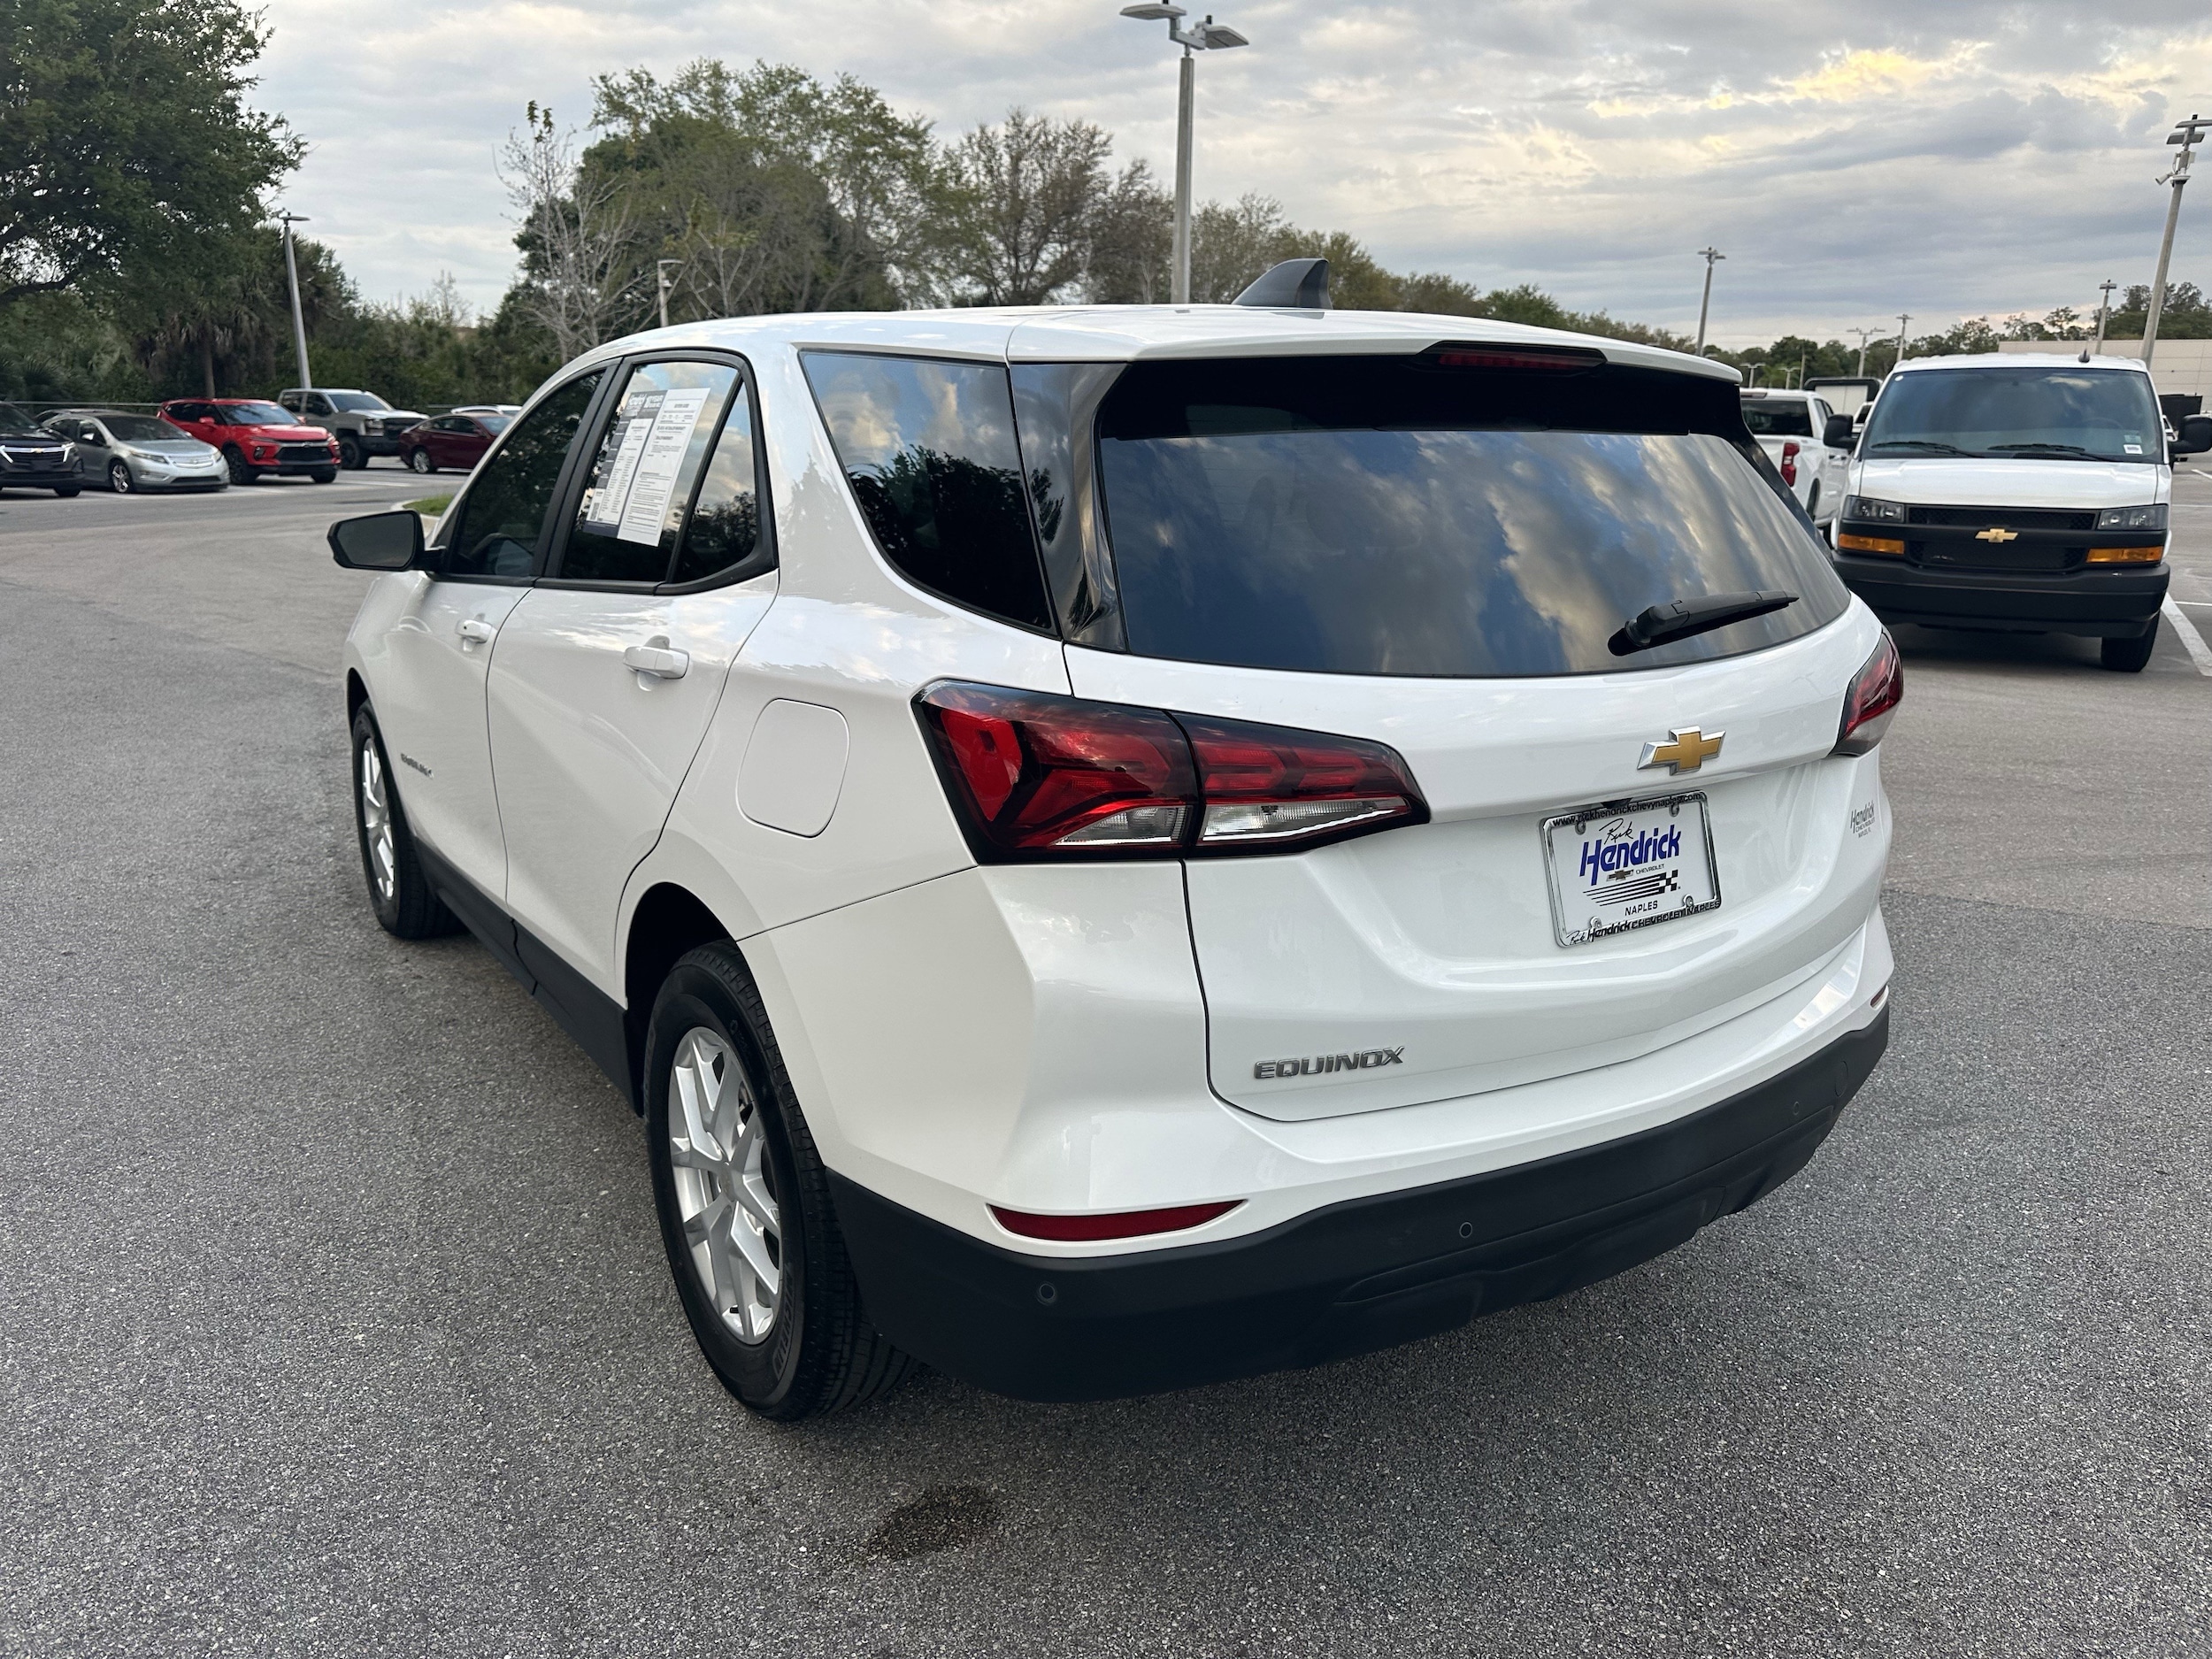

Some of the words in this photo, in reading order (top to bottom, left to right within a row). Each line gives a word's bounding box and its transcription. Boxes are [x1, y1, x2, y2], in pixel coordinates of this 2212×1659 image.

[1598, 818, 1634, 845] Rick
[1578, 824, 1682, 887] Hendrick
[1635, 864, 1665, 875] CHEVROLET
[1586, 919, 1632, 943] Hendrick
[1686, 900, 1720, 916] NAPLES
[1624, 900, 1659, 917] NAPLES
[1253, 1045, 1406, 1079] EQUINOX
